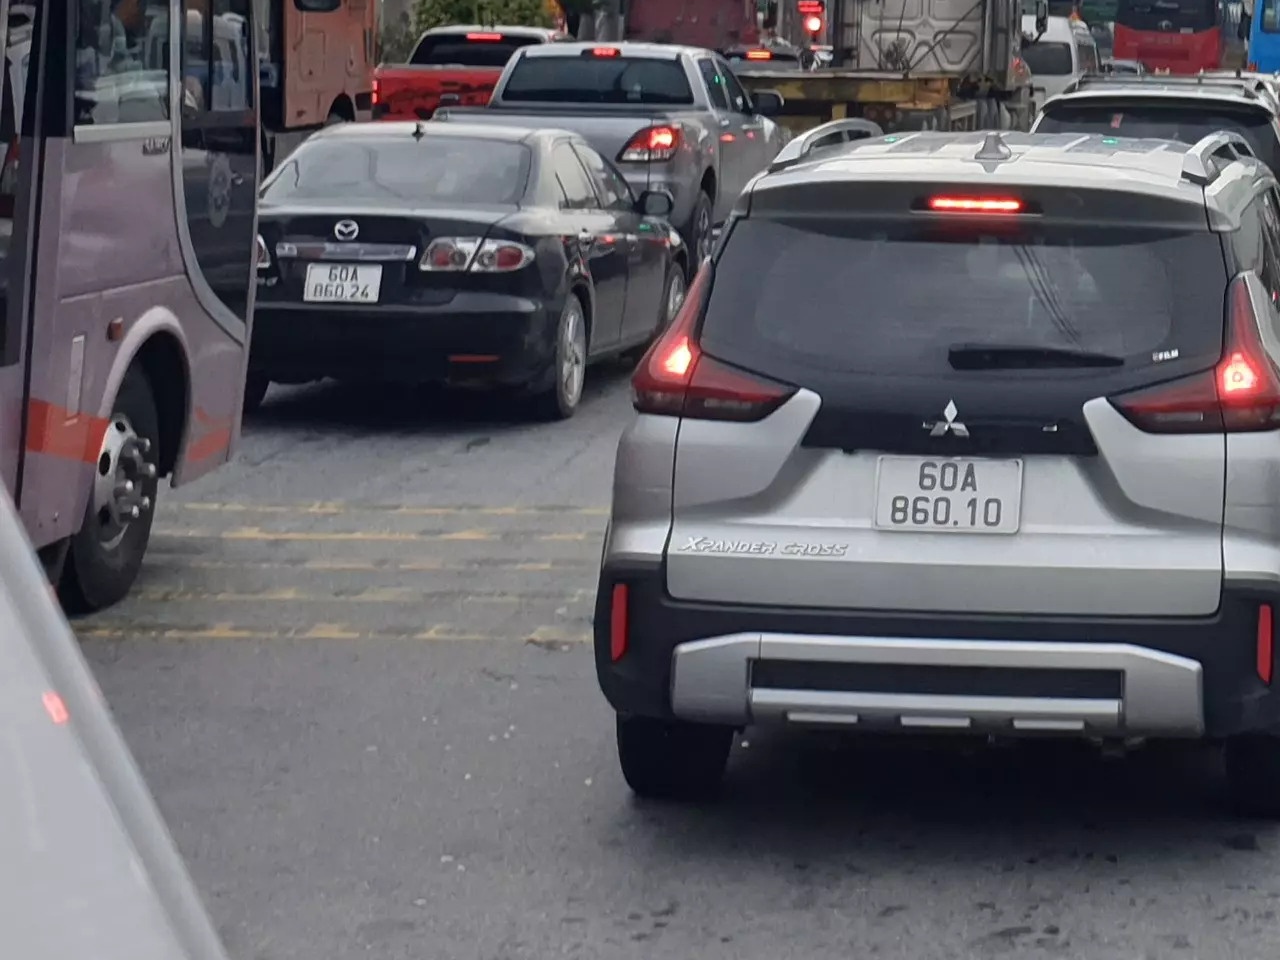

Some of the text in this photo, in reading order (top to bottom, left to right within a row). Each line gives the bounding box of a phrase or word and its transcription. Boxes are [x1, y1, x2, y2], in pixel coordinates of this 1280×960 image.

[328, 265, 359, 282] 60A
[918, 461, 978, 492] 60A
[890, 495, 1002, 527] 860.10
[680, 536, 848, 557] XPANDER CROSS
